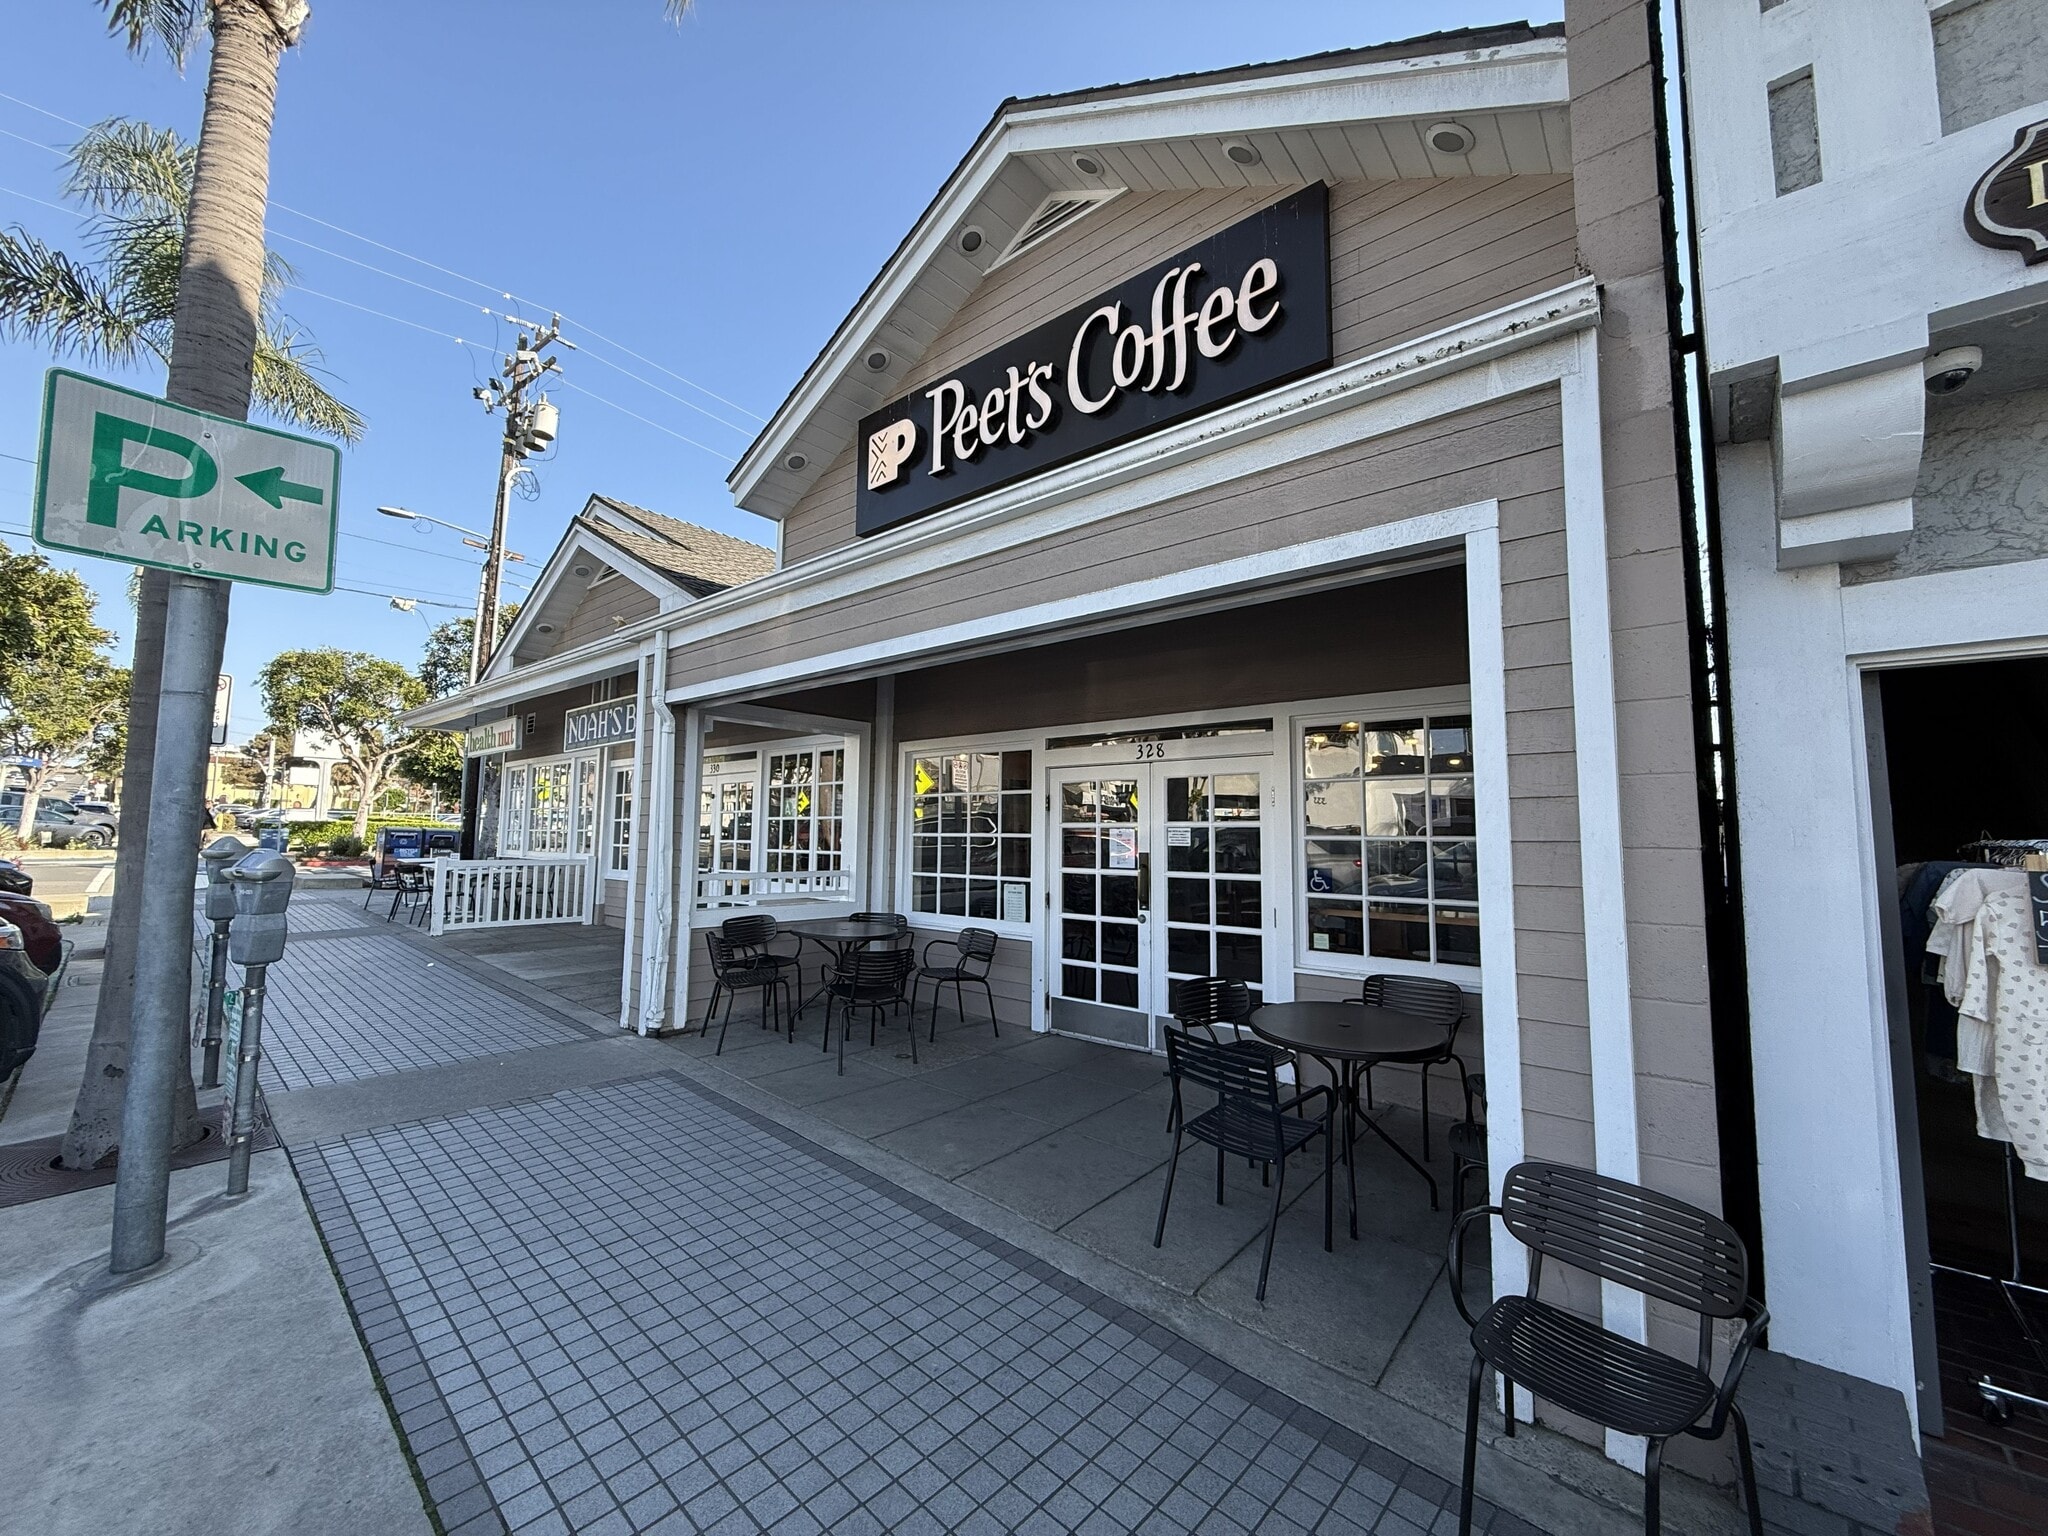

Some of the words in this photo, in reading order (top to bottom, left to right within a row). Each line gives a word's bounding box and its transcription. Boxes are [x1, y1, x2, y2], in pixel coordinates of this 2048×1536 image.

[925, 360, 1054, 476] Peet's
[1066, 258, 1280, 414] Coffee
[469, 726, 497, 752] health
[498, 723, 515, 748] nut
[568, 706, 623, 744] NOAH'S
[1136, 742, 1165, 760] 328
